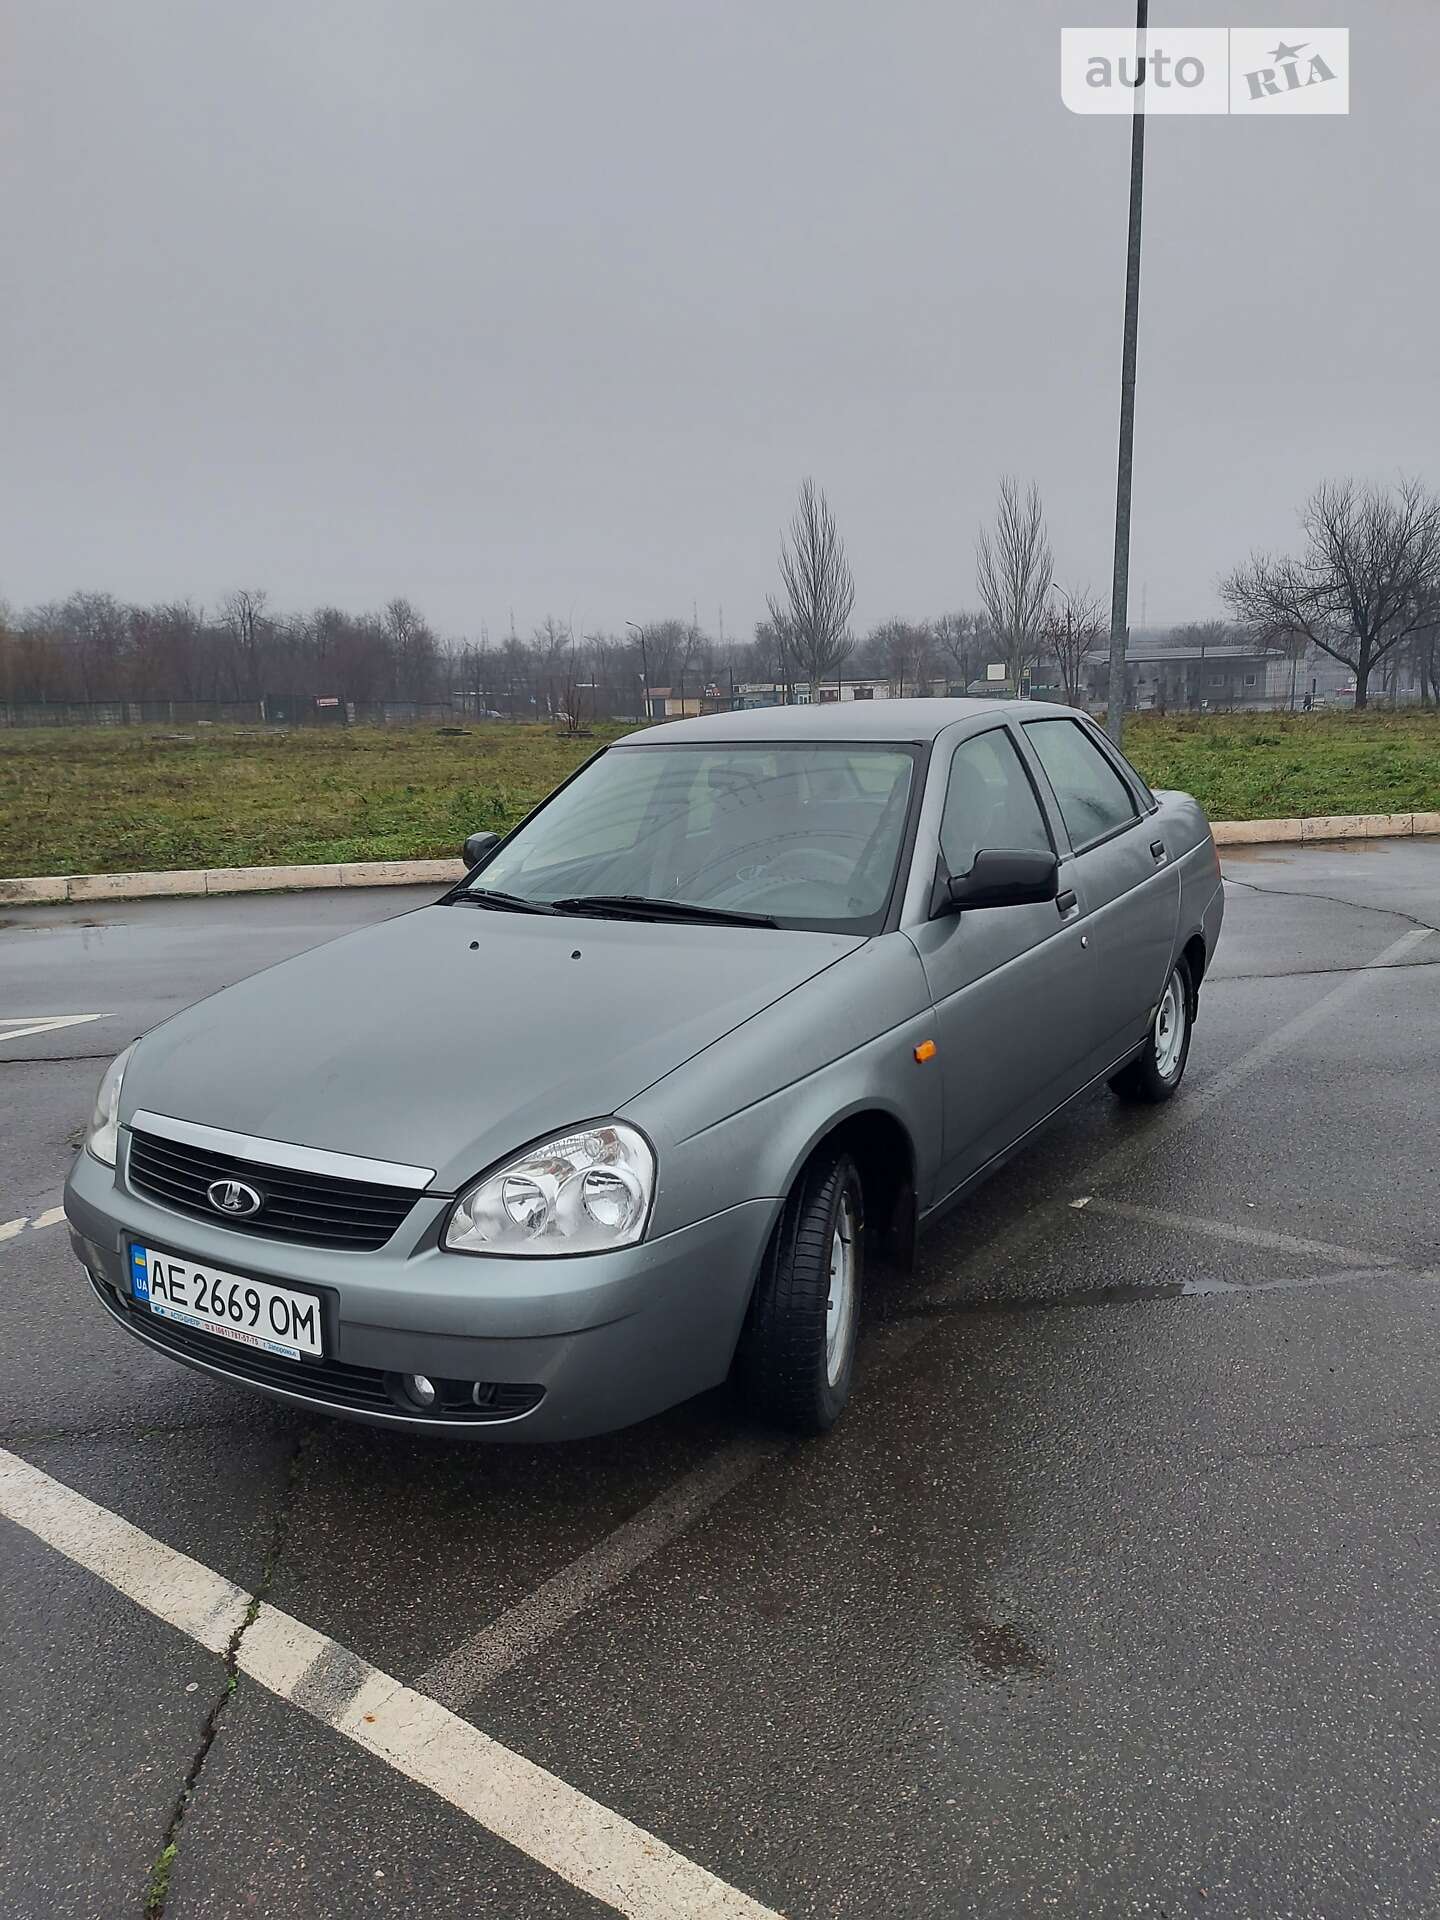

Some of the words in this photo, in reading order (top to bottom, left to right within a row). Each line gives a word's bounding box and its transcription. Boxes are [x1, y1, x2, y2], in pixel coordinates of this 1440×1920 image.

[136, 1278, 148, 1291] UA
[151, 1260, 188, 1306] AE
[193, 1273, 261, 1326] 2669
[269, 1295, 315, 1345] OM
